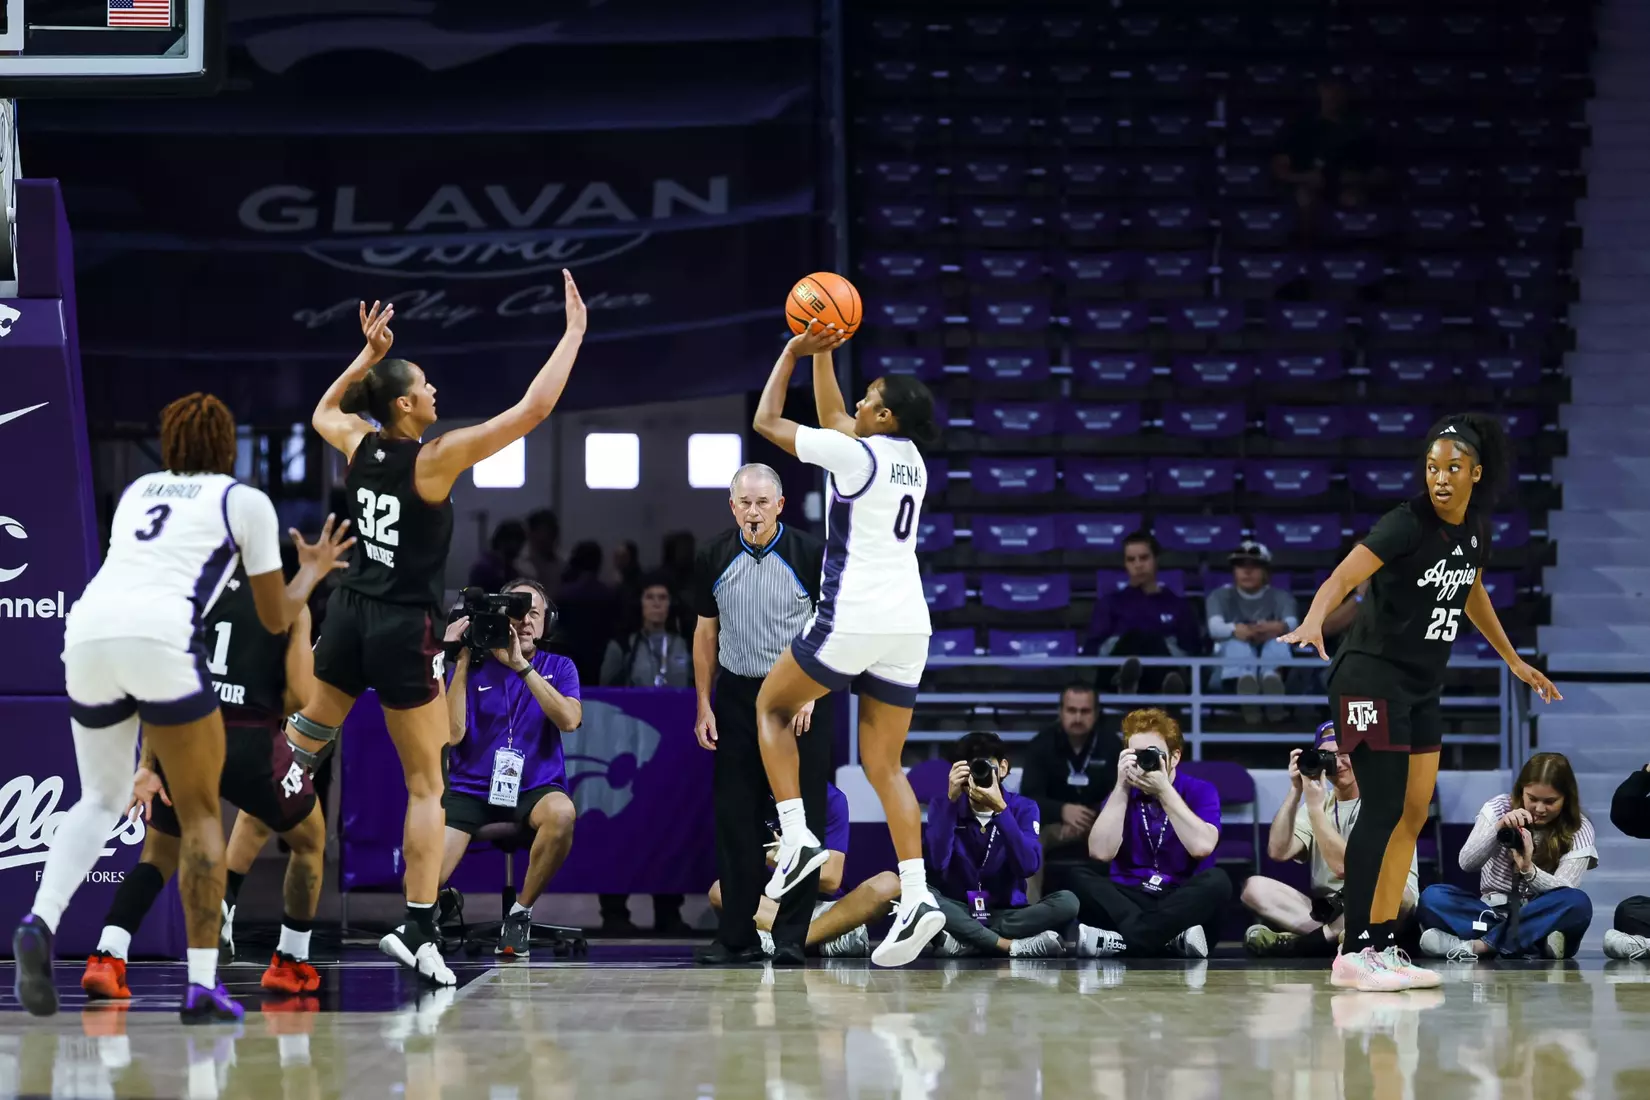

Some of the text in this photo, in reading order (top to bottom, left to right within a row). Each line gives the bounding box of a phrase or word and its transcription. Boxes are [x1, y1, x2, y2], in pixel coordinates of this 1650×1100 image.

[237, 175, 729, 233] GLAVAN
[135, 504, 172, 541] 3
[357, 486, 401, 547] 32
[893, 493, 916, 543] 0
[363, 540, 395, 569] WARE
[1417, 559, 1477, 602] Aggie
[1424, 607, 1462, 642] 25
[206, 621, 232, 676] 1
